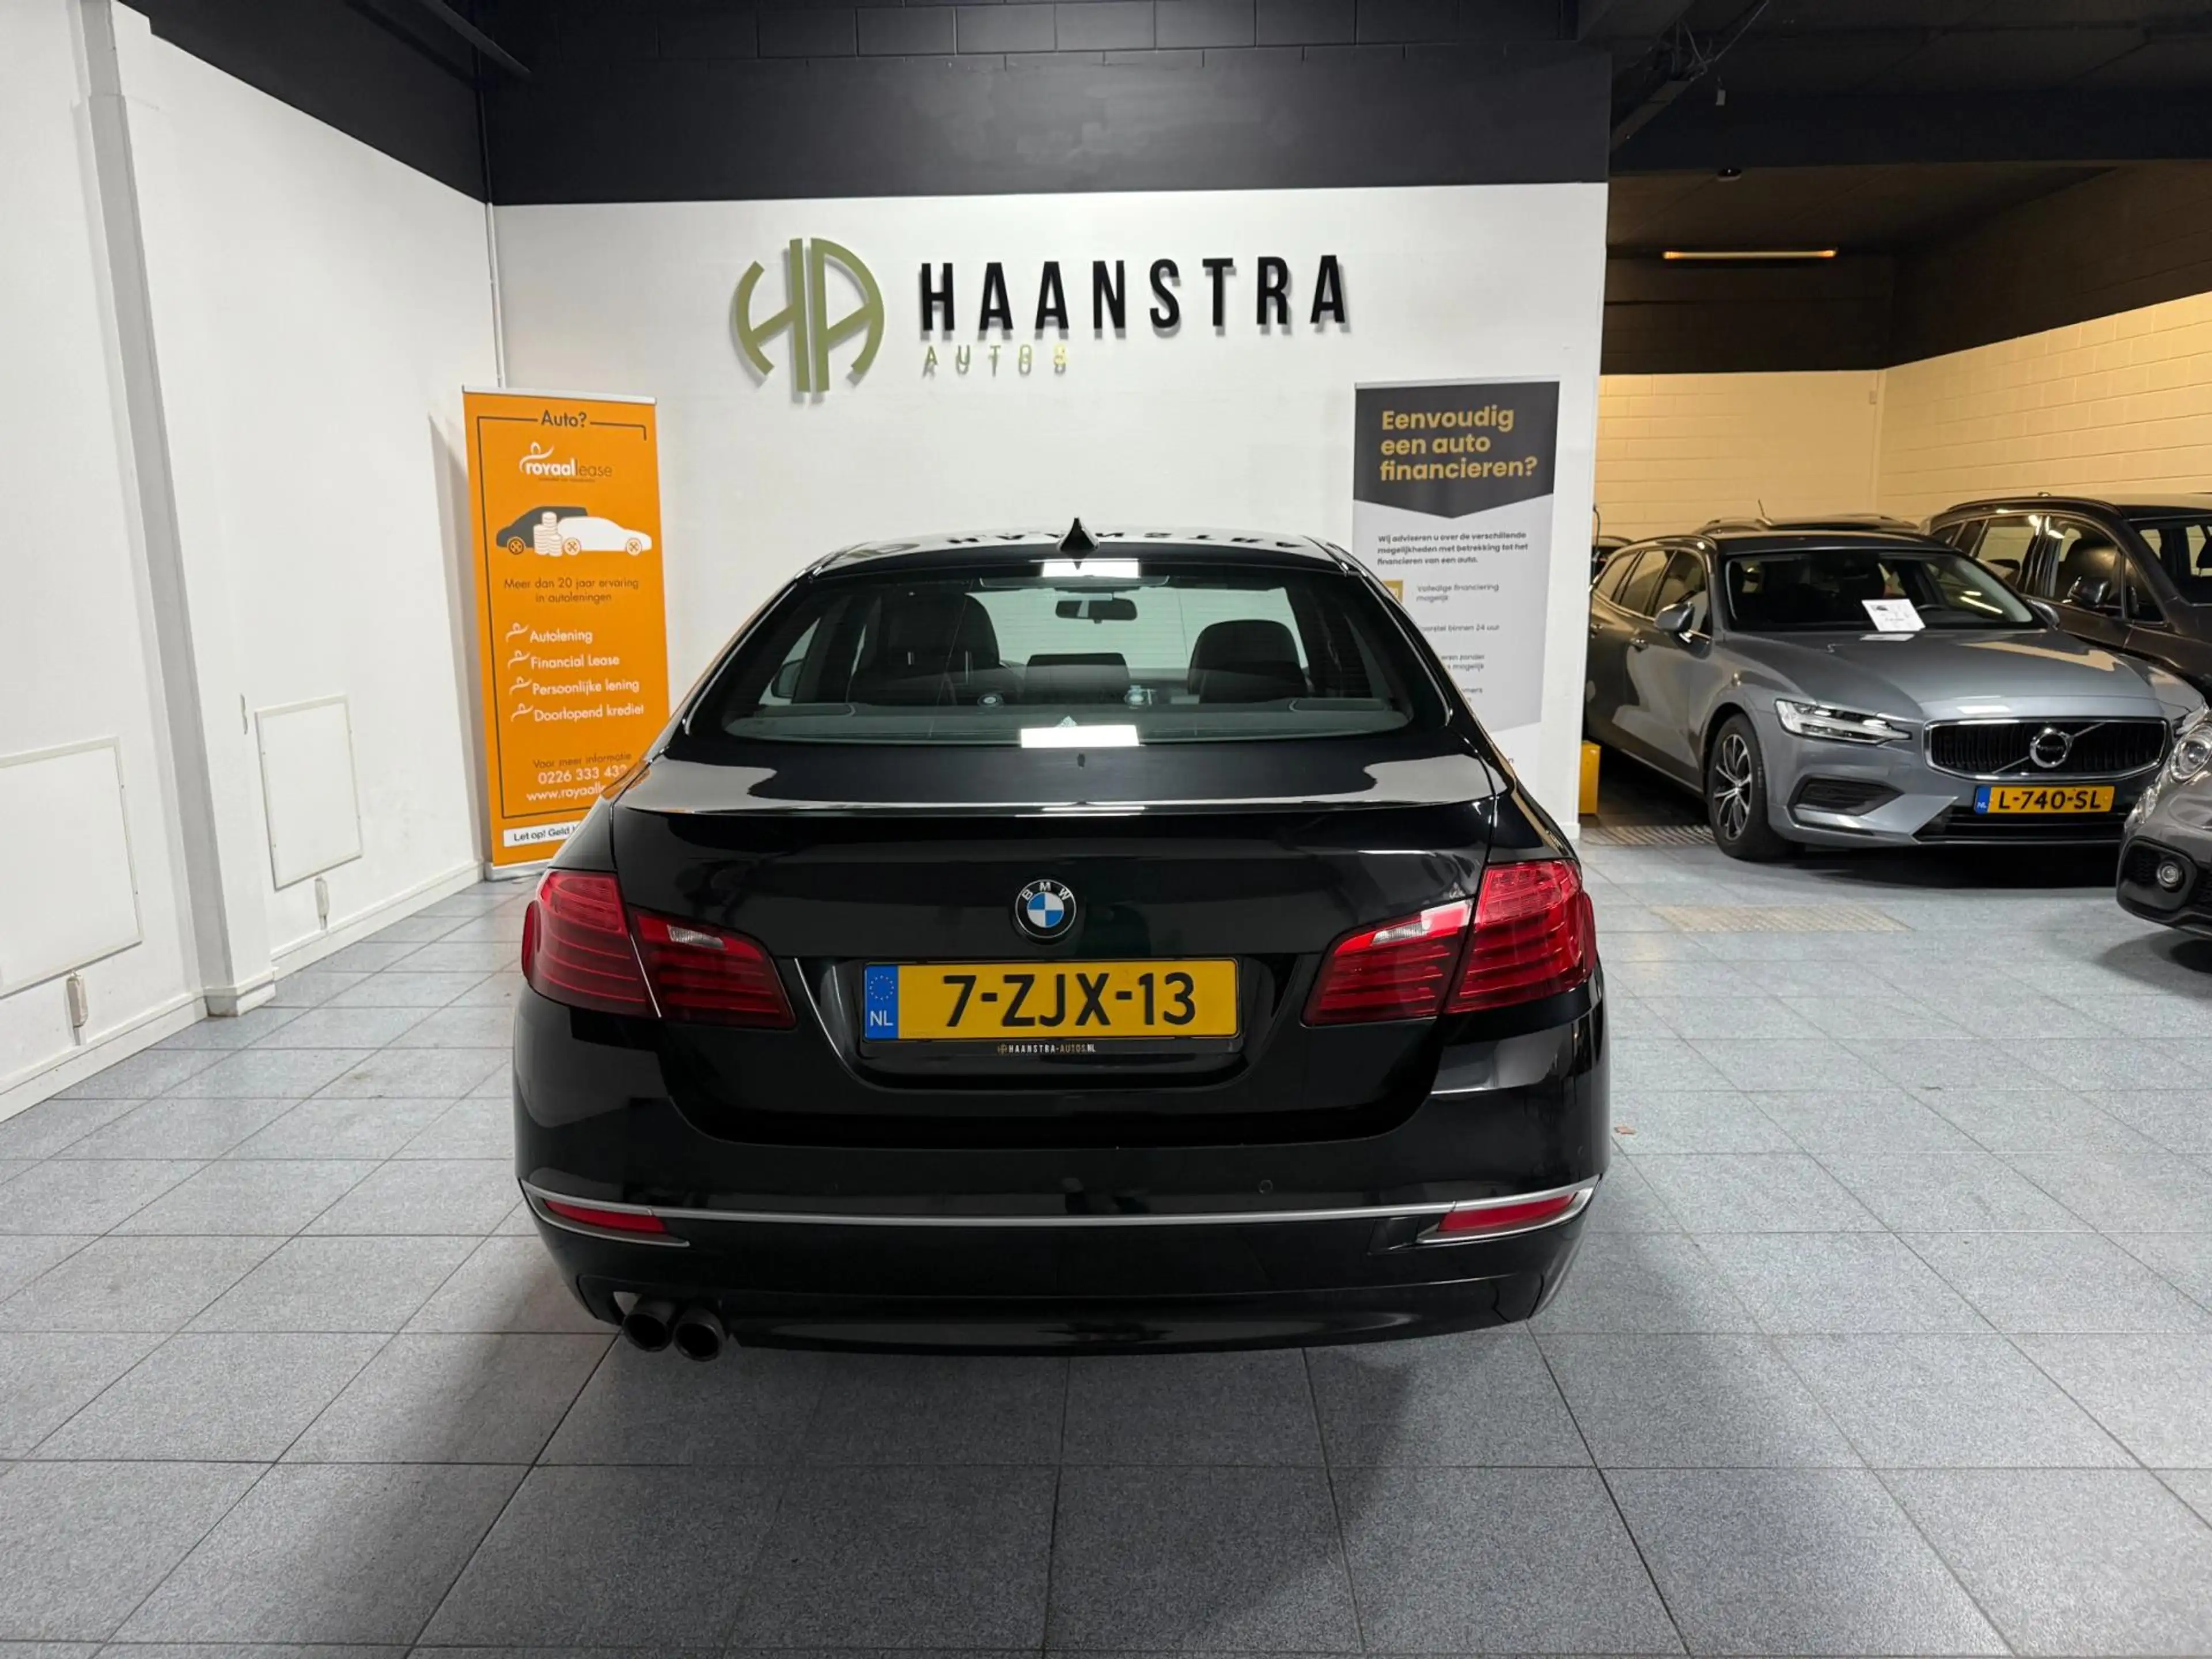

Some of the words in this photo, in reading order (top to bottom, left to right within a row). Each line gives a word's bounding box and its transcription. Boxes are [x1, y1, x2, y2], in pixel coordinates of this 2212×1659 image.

[922, 255, 1346, 331] HAANSTRA
[541, 410, 587, 427] Auto?
[1381, 404, 1514, 432] Eenvoudig
[1380, 439, 1427, 455] een
[1431, 434, 1491, 454] auto
[1380, 456, 1538, 481] financieren?
[503, 578, 531, 589] Meer
[535, 577, 555, 589] dan
[558, 577, 573, 589] 20
[575, 578, 595, 590] jaar
[599, 578, 639, 590] ervaring
[535, 592, 545, 603] in
[547, 591, 612, 605] autoleningen
[530, 628, 593, 645] Autolening
[531, 654, 585, 669] Financial
[588, 654, 620, 666] Lease
[532, 679, 602, 696] Persoonlijke
[604, 677, 640, 693] lening
[534, 704, 603, 723] Doorlopend
[606, 702, 644, 716] krediet
[532, 759, 555, 769] Voor
[559, 757, 582, 767] meer
[585, 752, 632, 764] informatie
[537, 769, 572, 785] 0226
[575, 767, 600, 781] 333
[1998, 789, 2101, 810] L-740-SL
[513, 832, 529, 842] Let
[531, 830, 546, 841] op!
[548, 826, 570, 838] Geld
[1021, 881, 1072, 901] BMW
[943, 972, 1196, 1028] 7-ZJX-13
[870, 1009, 893, 1027] NL
